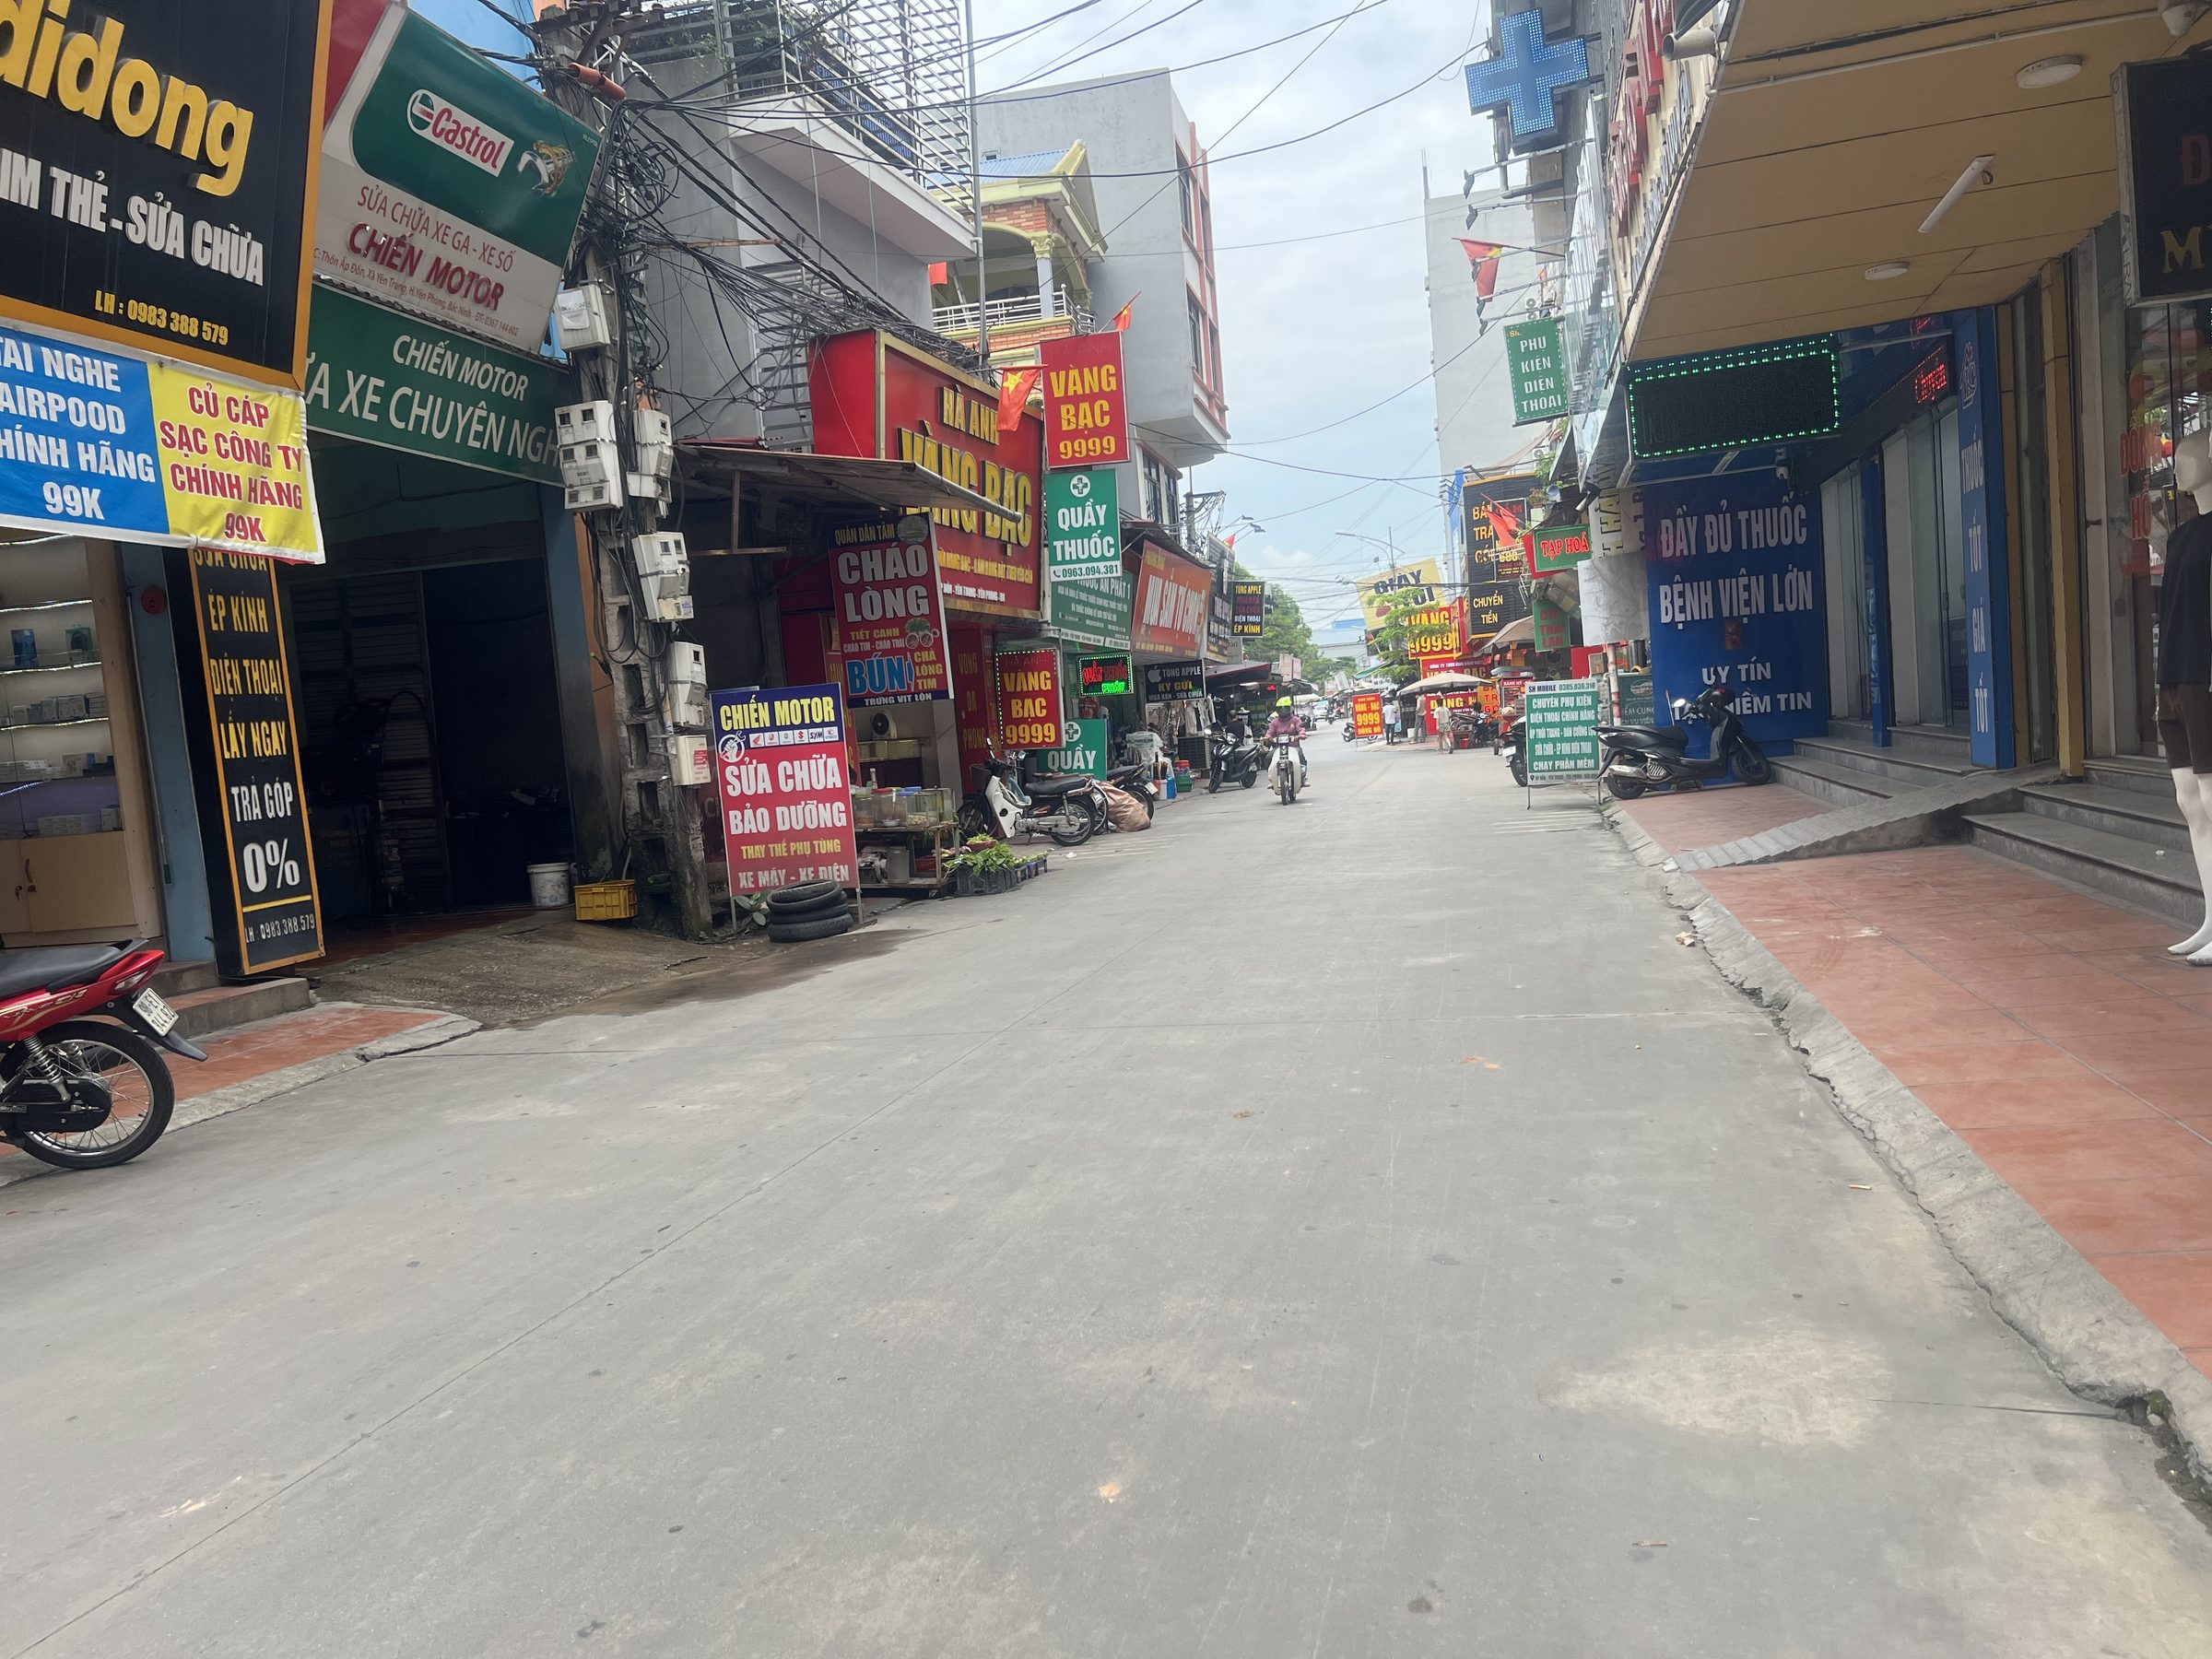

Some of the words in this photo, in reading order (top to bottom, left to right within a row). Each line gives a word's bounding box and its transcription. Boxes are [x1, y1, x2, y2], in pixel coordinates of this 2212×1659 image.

[431, 106, 507, 170] Castrol
[50, 170, 109, 232] THẺ
[125, 191, 184, 259] SỬA
[191, 219, 264, 287] CHỮA
[358, 184, 388, 220] SỬA
[391, 199, 429, 236] CHỮA
[430, 220, 452, 246] XE
[452, 230, 471, 255] GA
[480, 241, 496, 265] XE
[495, 249, 516, 273] SỐ
[347, 222, 424, 277] CHIẾN
[426, 256, 505, 312] MOTOR
[376, 272, 388, 286] Yên
[95, 289, 115, 314] LH
[128, 299, 168, 328] 0983
[170, 312, 199, 338] 388
[202, 322, 229, 347] 579
[0, 337, 33, 371] AI
[41, 347, 122, 393] NGHE
[393, 335, 460, 379] CHIẾN
[458, 356, 529, 402] MOTOR
[1050, 364, 1117, 398] VÀNG
[0, 385, 125, 435] AIRPOOD
[188, 382, 219, 419] CỦ
[226, 394, 271, 429] CÁP
[338, 370, 385, 422] XE
[389, 386, 507, 453] CHUYÊN
[941, 384, 966, 430] HÀ
[969, 400, 1000, 445] ANH
[1060, 400, 1111, 434] BẠC
[76, 440, 156, 484] HÃNG
[159, 420, 208, 459] SẠC
[214, 430, 273, 468] CÔNG
[277, 445, 302, 473] TY
[1059, 435, 1116, 459] 9999
[1961, 425, 1983, 494] THUỐC
[42, 481, 105, 520] 99K
[170, 463, 243, 502] CHÍNH
[248, 475, 303, 511] HÃNG
[224, 512, 266, 543] 99K
[983, 460, 1032, 557] BẠC
[1057, 499, 1107, 532] QUẦY
[1661, 505, 1698, 559] ĐẦY
[1705, 500, 1733, 554] ĐỦ
[1737, 491, 1807, 550] THUỐC
[1053, 529, 1115, 561] THUỐC
[1541, 540, 1562, 560] TẠP
[1968, 509, 1982, 573] TỐT
[837, 542, 929, 585] CHÁO
[1062, 564, 1119, 579] 0963.094.381
[207, 588, 226, 631] ÉP
[230, 591, 269, 633] KÍNH
[844, 584, 930, 623] LÒNG
[1659, 575, 1713, 630] BỆNH
[1719, 568, 1765, 624] VIỆN
[1772, 564, 1814, 613] LỚN
[873, 627, 900, 640] CANH
[1972, 597, 1985, 653] GIÁ
[242, 659, 284, 701] THOẠI
[845, 652, 907, 694] BÚN
[915, 662, 943, 677] LÒNG
[916, 678, 937, 690] TIM
[1004, 669, 1052, 692] VÀNG
[1537, 684, 1556, 692] MOBILE
[1737, 656, 1771, 682] TÍN
[720, 694, 771, 731] CHIẾN
[774, 697, 835, 730] MOTOR
[1011, 698, 1047, 722] BẠC
[1357, 712, 1380, 725] 9999
[1777, 692, 1812, 712] TIN
[1975, 672, 1988, 733] TỐT
[220, 709, 246, 759] LẤY
[250, 721, 288, 758] NGAY
[809, 731, 823, 740] SYM
[1006, 723, 1056, 745] 9999
[725, 758, 773, 797] SỬA
[777, 754, 842, 793] CHỮA
[1047, 744, 1097, 770] QUẦY
[230, 775, 263, 822] TRẢ
[265, 776, 294, 818] GÓP
[729, 803, 771, 835] BẢO
[776, 800, 847, 831] DƯỠNG
[242, 838, 300, 893] 0%
[741, 844, 766, 860] THAY
[769, 840, 788, 857] THẾ
[790, 841, 811, 857] PHỤ
[813, 839, 841, 854] TÙNG
[738, 872, 755, 888] XE
[758, 867, 786, 888] MÁY
